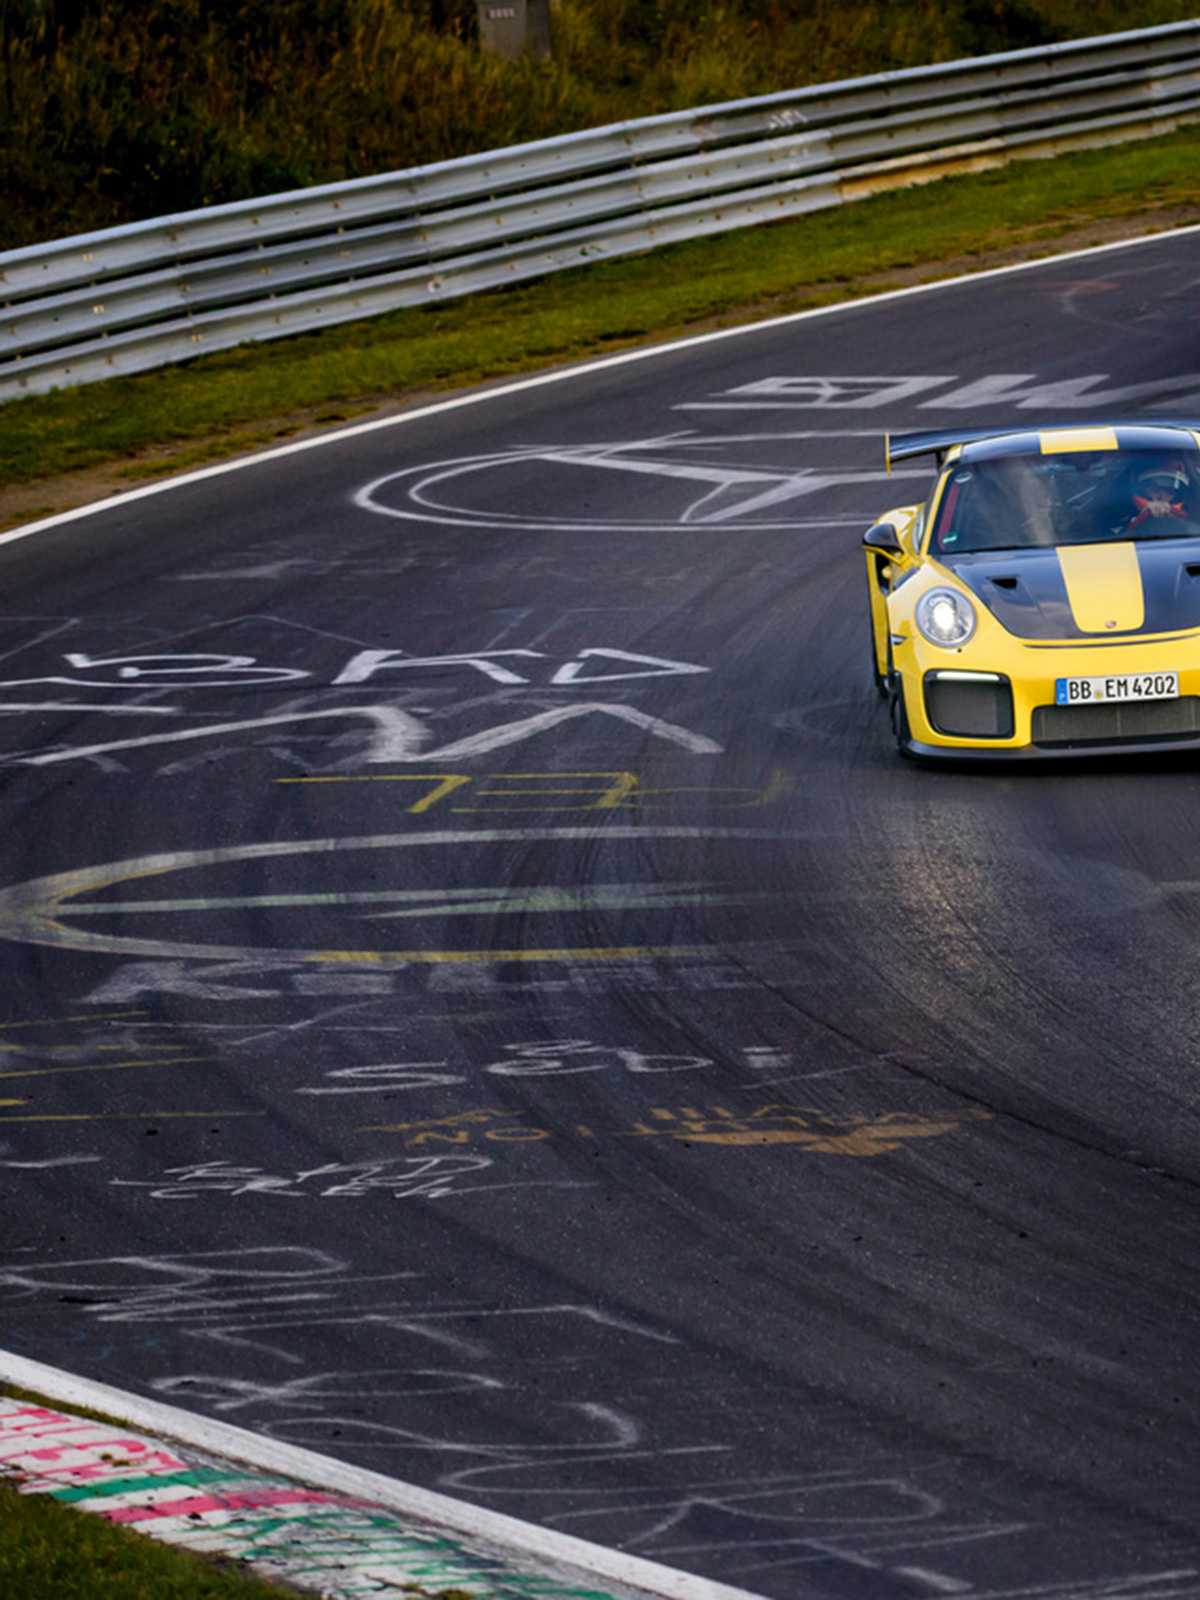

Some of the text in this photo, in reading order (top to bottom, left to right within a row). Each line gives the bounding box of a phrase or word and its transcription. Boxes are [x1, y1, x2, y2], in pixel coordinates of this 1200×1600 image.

[1069, 675, 1176, 700] BB EM 4202
